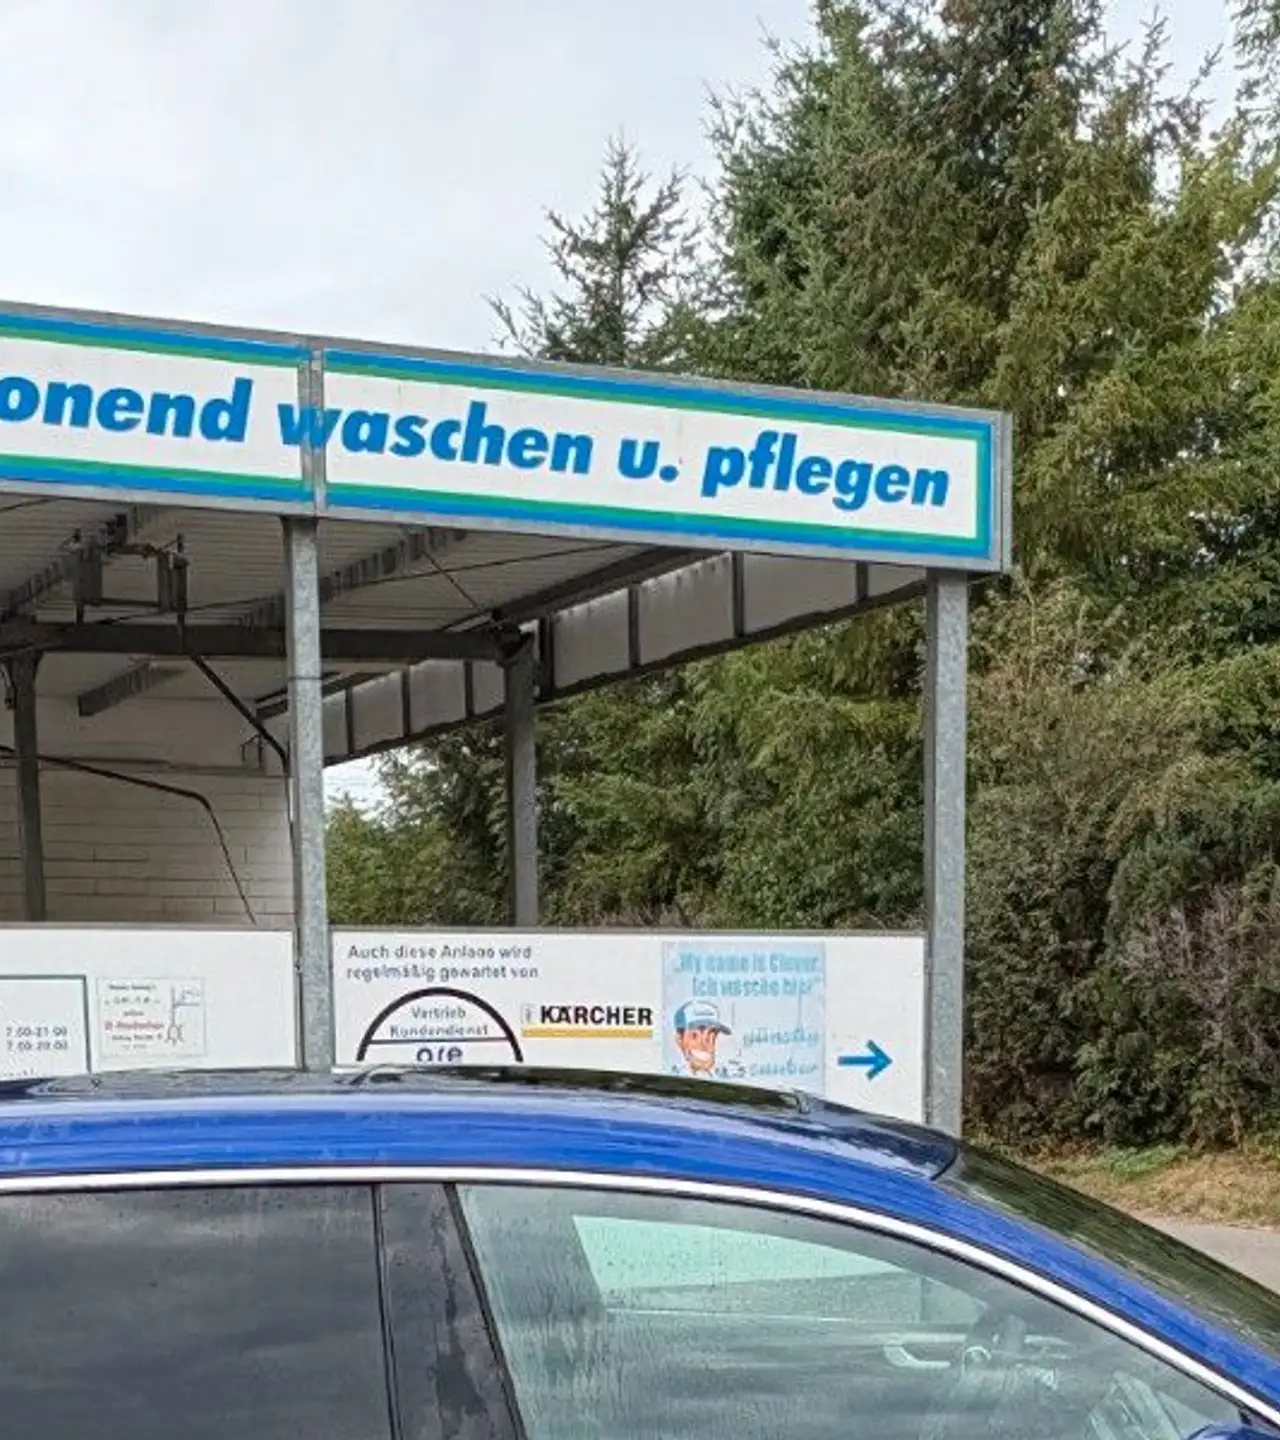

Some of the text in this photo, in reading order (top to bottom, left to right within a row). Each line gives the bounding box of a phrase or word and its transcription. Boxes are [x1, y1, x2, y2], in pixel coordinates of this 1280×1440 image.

[278, 401, 593, 475] waschen
[618, 440, 677, 481] u.
[701, 430, 949, 511] pflegen
[347, 945, 389, 959] Auch
[394, 946, 437, 959] diese
[499, 945, 532, 959] wird
[439, 966, 506, 982] gewartet
[510, 967, 538, 978] von
[412, 1006, 466, 1019] Vertrieb
[389, 1025, 488, 1038] Kundendienst
